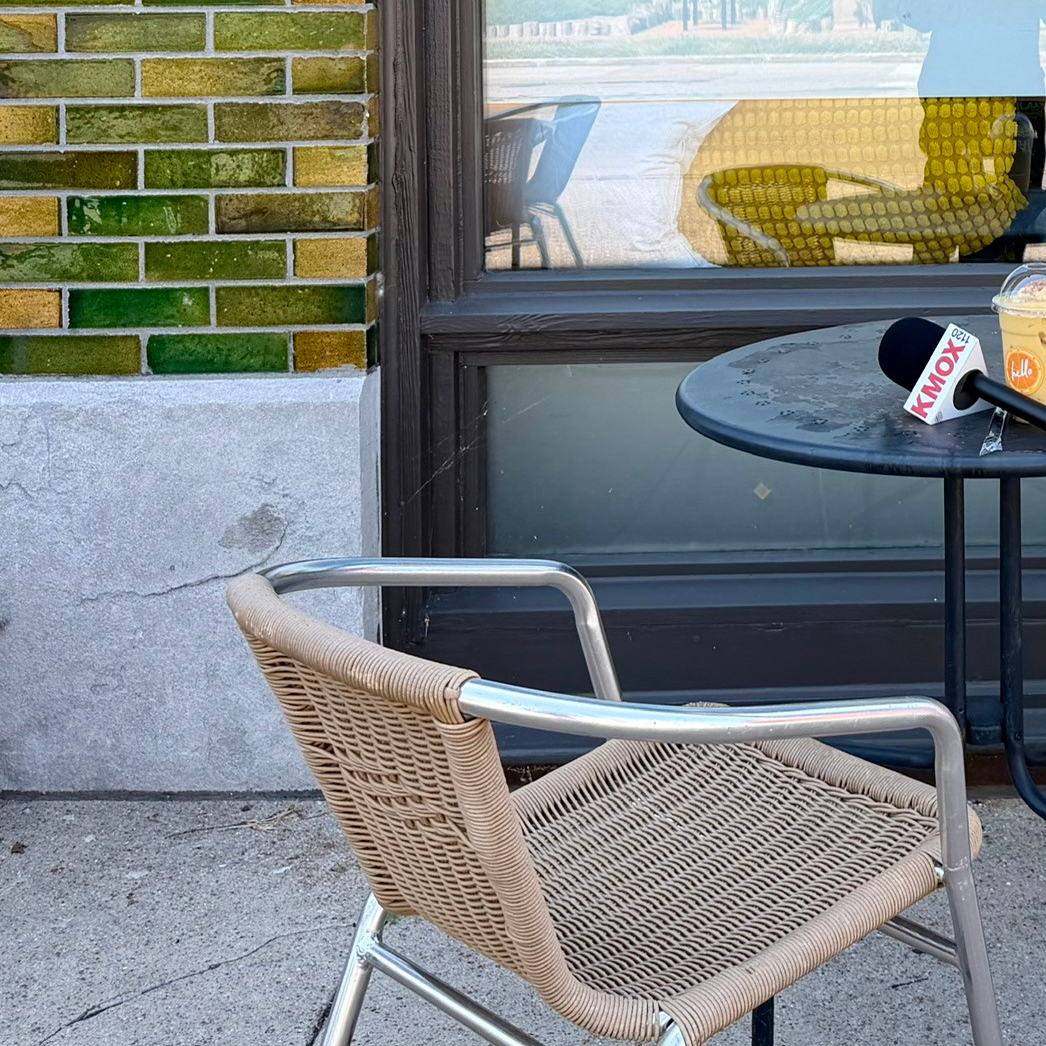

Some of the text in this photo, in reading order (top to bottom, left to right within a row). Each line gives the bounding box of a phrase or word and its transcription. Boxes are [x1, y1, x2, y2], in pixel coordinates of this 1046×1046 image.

[951, 328, 970, 344] 1120
[911, 339, 966, 418] KMOX
[1011, 359, 1033, 381] hello
